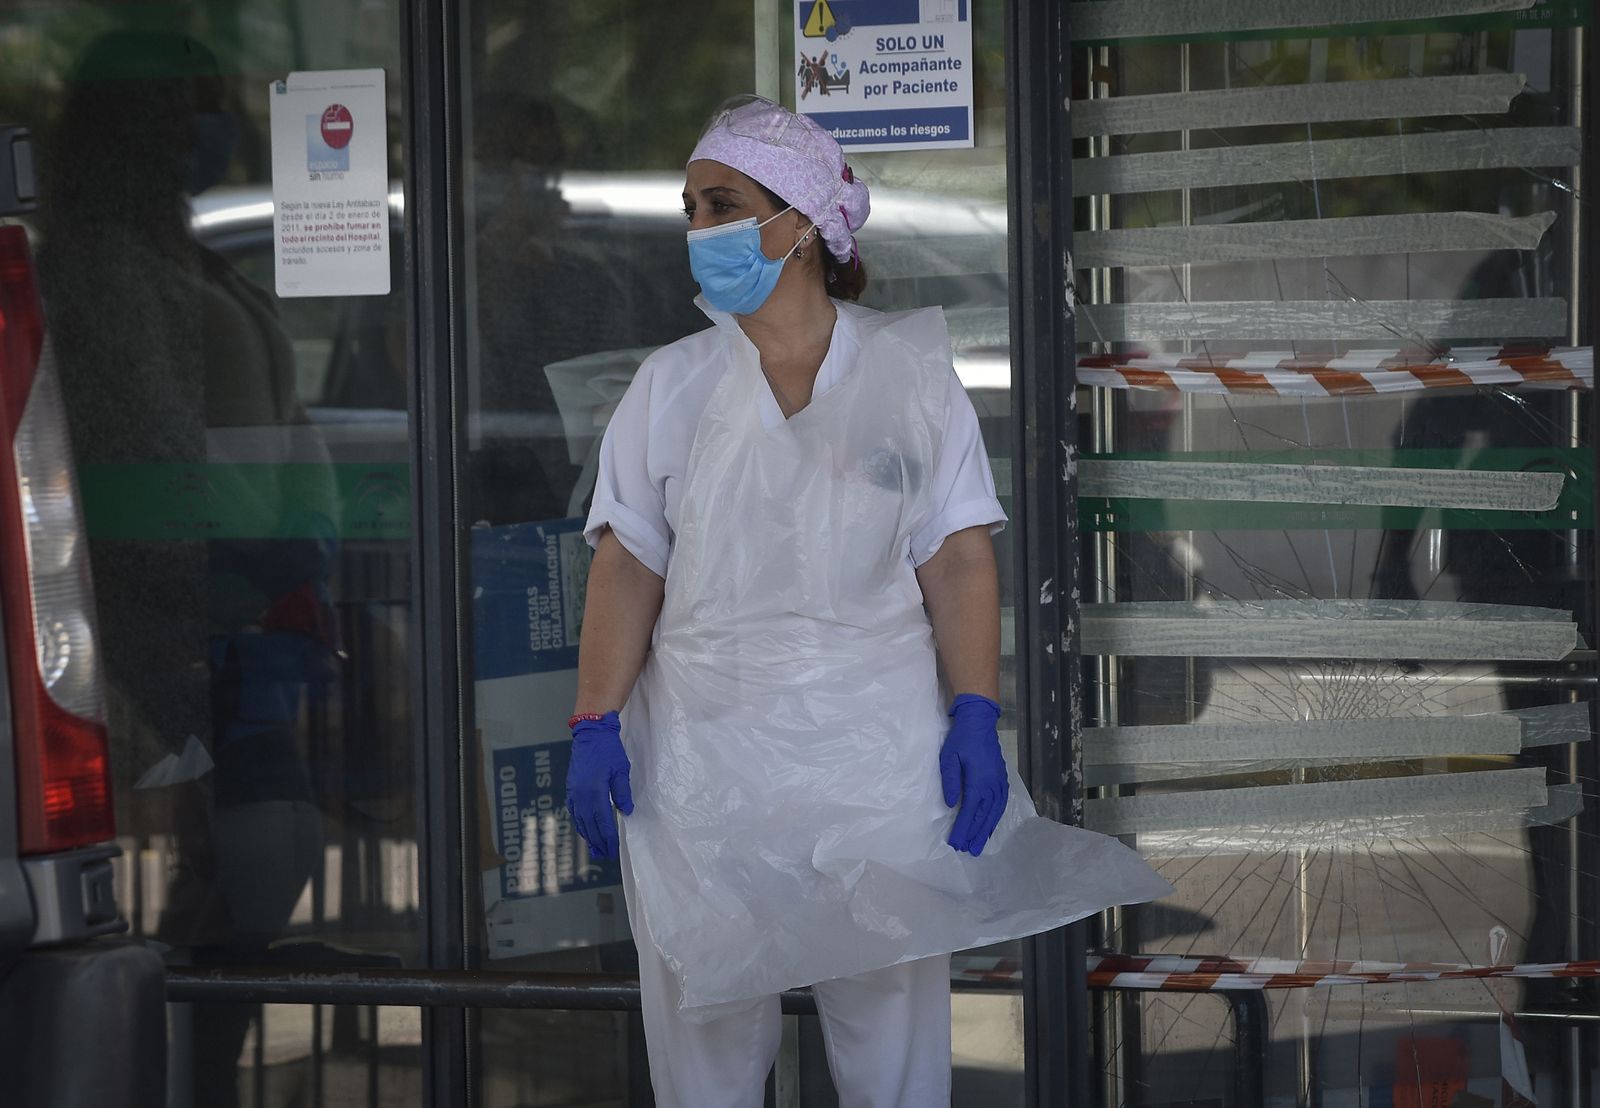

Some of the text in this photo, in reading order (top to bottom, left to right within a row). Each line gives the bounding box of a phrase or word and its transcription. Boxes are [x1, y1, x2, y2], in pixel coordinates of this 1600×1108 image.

[876, 34, 945, 51] SOLO UN
[859, 56, 962, 77] Acompañante
[864, 78, 958, 99] por Paciente
[890, 125, 907, 136] los
[909, 123, 950, 138] riesgos
[309, 171, 345, 180] sin humo
[281, 201, 303, 212] Según
[304, 201, 310, 209] la
[332, 201, 344, 210] Ley
[346, 199, 380, 208] Antitabaco
[281, 213, 303, 221] desde
[306, 212, 313, 220] el
[329, 211, 334, 219] 2
[336, 211, 345, 219] de
[348, 211, 369, 219] enero
[346, 222, 369, 230] fumar
[281, 235, 298, 243] todo
[299, 235, 307, 243] el
[308, 234, 335, 242] recinto
[336, 233, 347, 241] del
[281, 245, 314, 254] incluidos
[347, 245, 351, 254] y
[373, 244, 382, 252] de
[544, 534, 563, 648] COLABORACIÓN
[528, 586, 541, 651] GRACIAS
[539, 595, 553, 650] POR SU
[534, 750, 552, 788] SIN
[500, 765, 521, 894] PROHIBIDO
